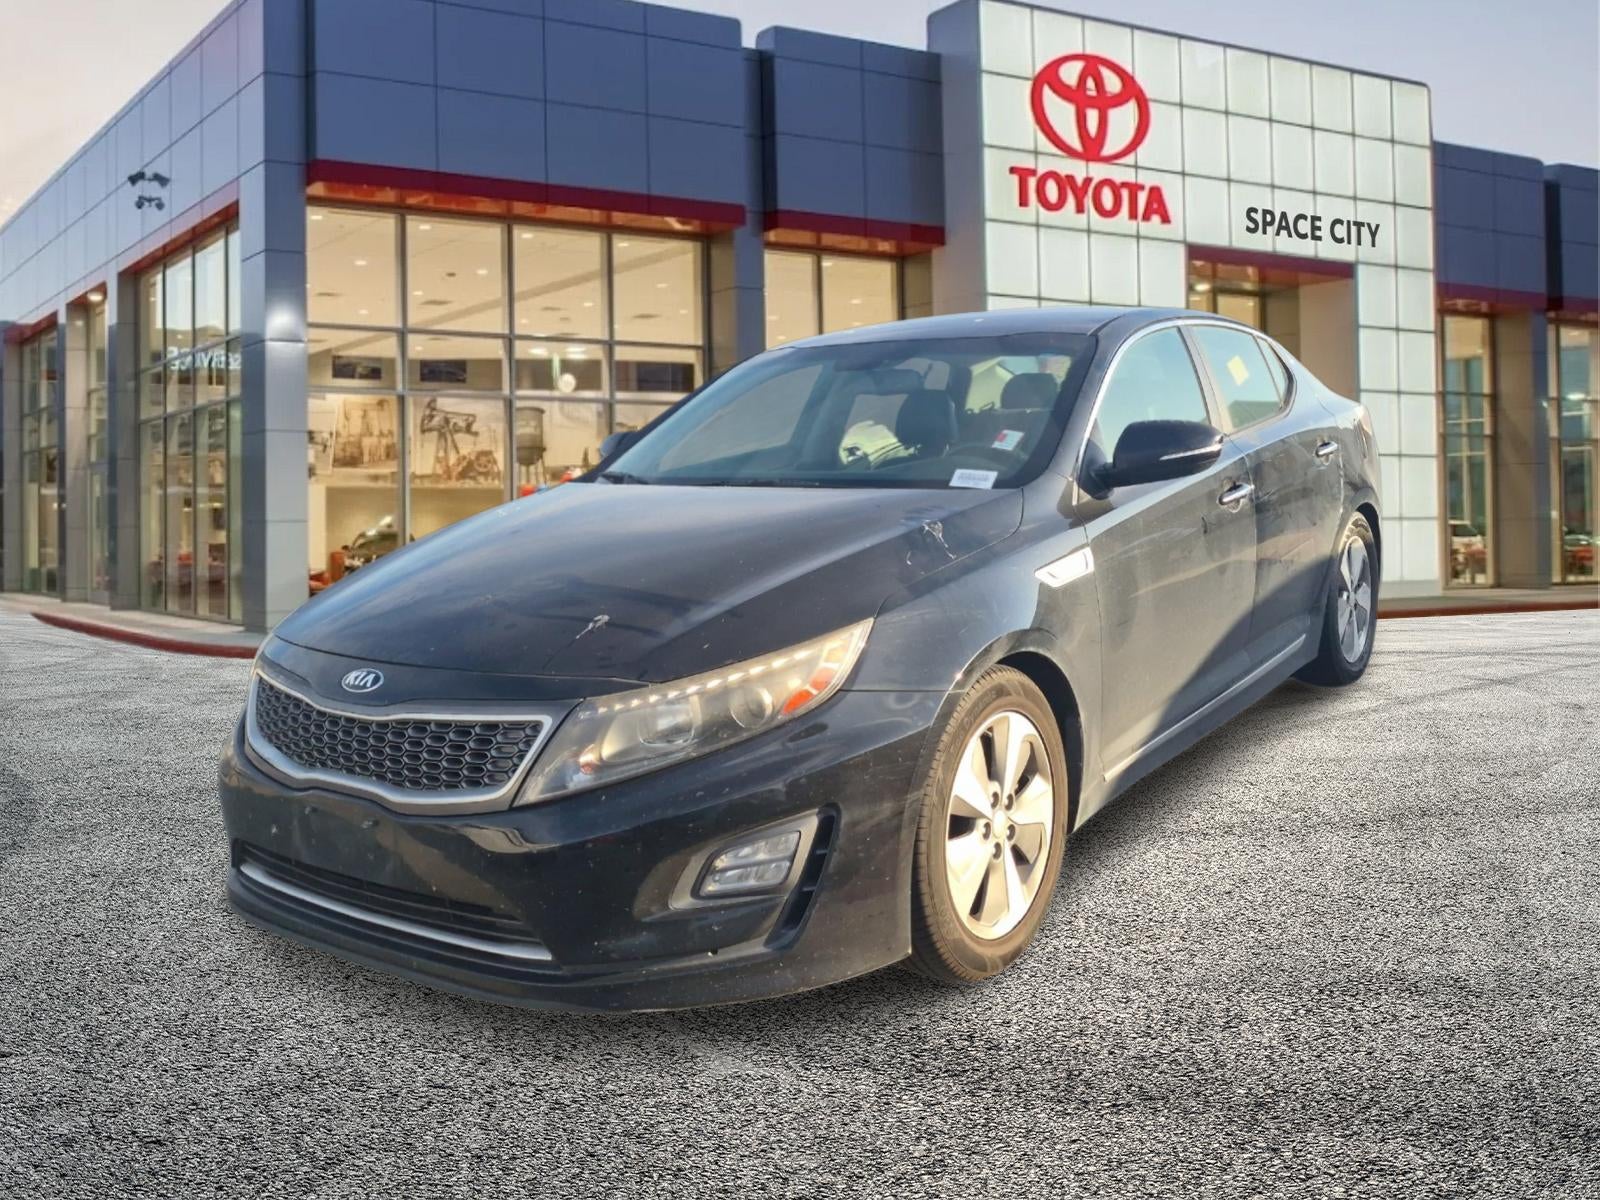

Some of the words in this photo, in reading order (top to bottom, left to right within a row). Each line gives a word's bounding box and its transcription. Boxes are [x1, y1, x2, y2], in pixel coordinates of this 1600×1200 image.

[1009, 166, 1172, 225] TOYOTA
[1245, 206, 1323, 242] SPACE
[1329, 217, 1381, 248] CITY
[345, 671, 377, 688] KIA
